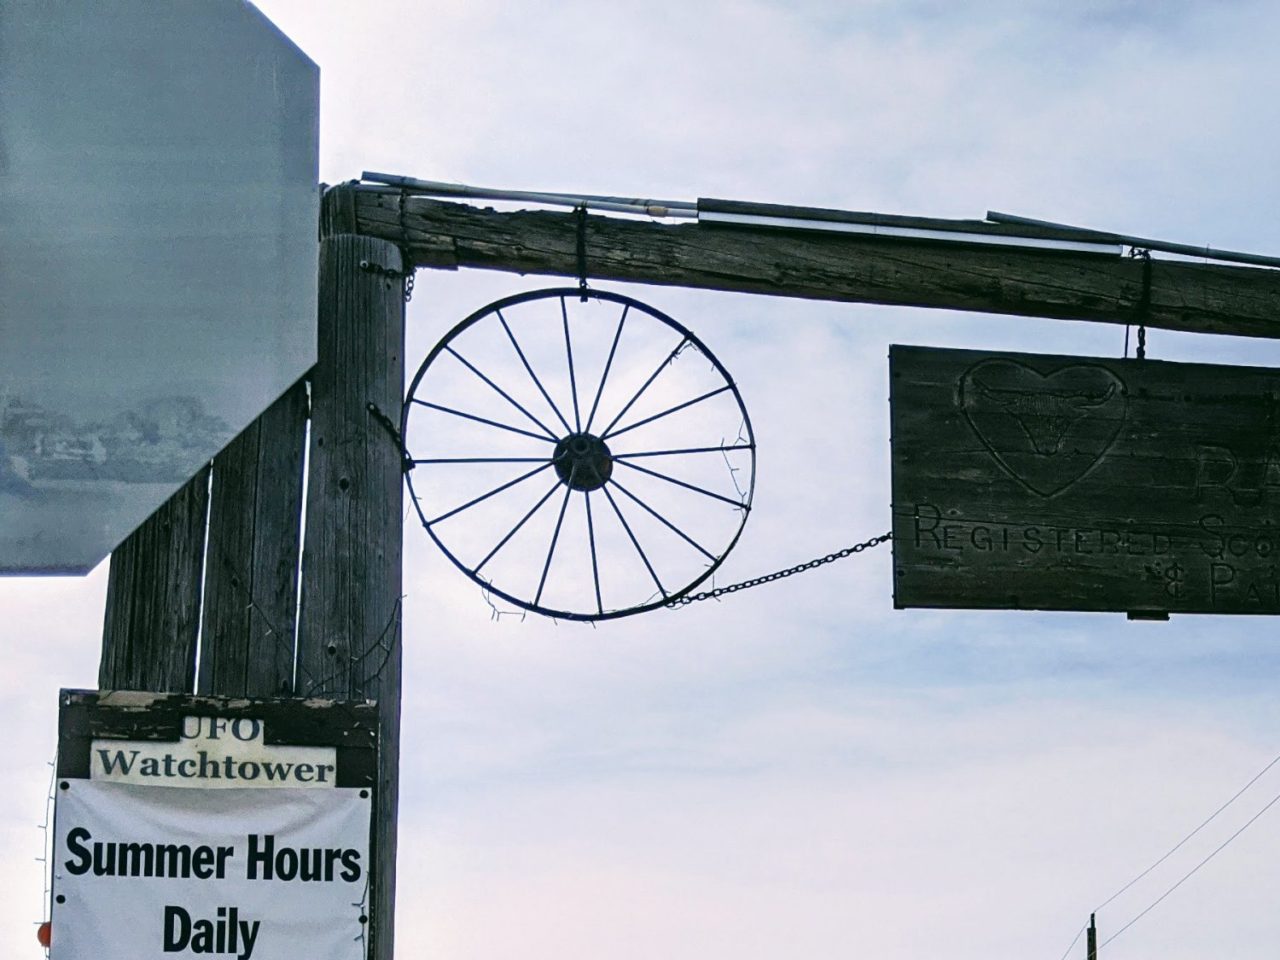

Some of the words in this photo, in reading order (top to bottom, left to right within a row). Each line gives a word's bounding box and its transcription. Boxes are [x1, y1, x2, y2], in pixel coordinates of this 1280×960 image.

[912, 503, 1171, 555] REGISTERED
[180, 715, 260, 741] UFO
[96, 749, 335, 783] Watchtower
[65, 827, 234, 880] Summer
[246, 834, 361, 882] Hours
